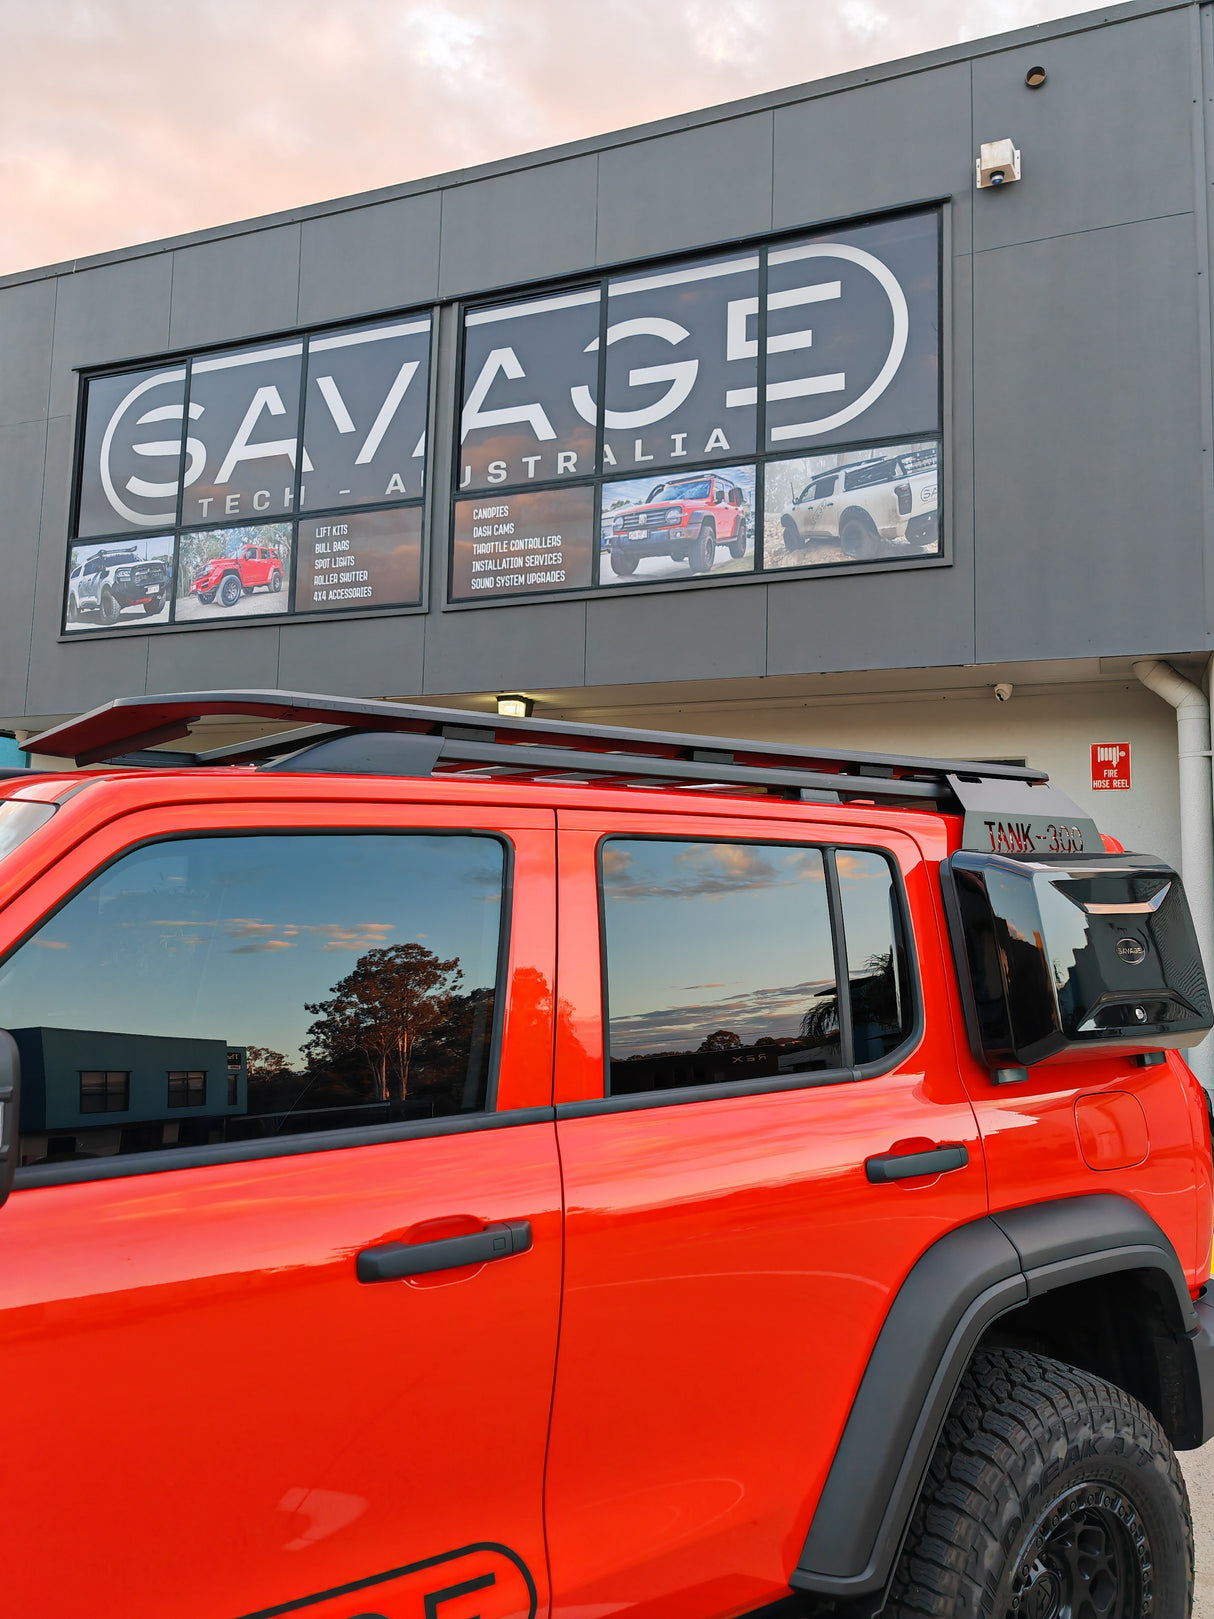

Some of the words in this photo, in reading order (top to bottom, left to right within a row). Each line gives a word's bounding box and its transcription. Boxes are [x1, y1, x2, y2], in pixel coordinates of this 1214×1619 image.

[125, 280, 846, 498] SAVAGE
[198, 485, 306, 518] TECH
[473, 505, 509, 520] CANOPIES
[315, 526, 331, 538] LIFT
[332, 524, 348, 536] KITS
[473, 525, 492, 538] DASH
[493, 523, 515, 536] CAMS
[315, 542, 331, 554] BULL
[333, 540, 350, 552] BARS
[473, 541, 508, 555] THROTTLE
[510, 535, 562, 551] CONTROLLERS
[314, 558, 331, 570] SPOT
[331, 555, 355, 568] LIGHTS
[472, 557, 523, 572] INSTALLATION
[525, 553, 563, 567] SERVICES
[313, 573, 338, 586] ROLLER
[339, 570, 368, 583] SHUTTER
[471, 578, 495, 590] SOUND
[496, 574, 525, 588] SYSTEM
[527, 570, 566, 585] UPGRADES
[313, 591, 327, 602] 4X4
[328, 586, 373, 600] ACCESSORIES
[1103, 769, 1119, 778] FIRE
[1093, 779, 1110, 788] HOSE
[1112, 779, 1130, 788] REEL
[984, 821, 1084, 853] TANK-300
